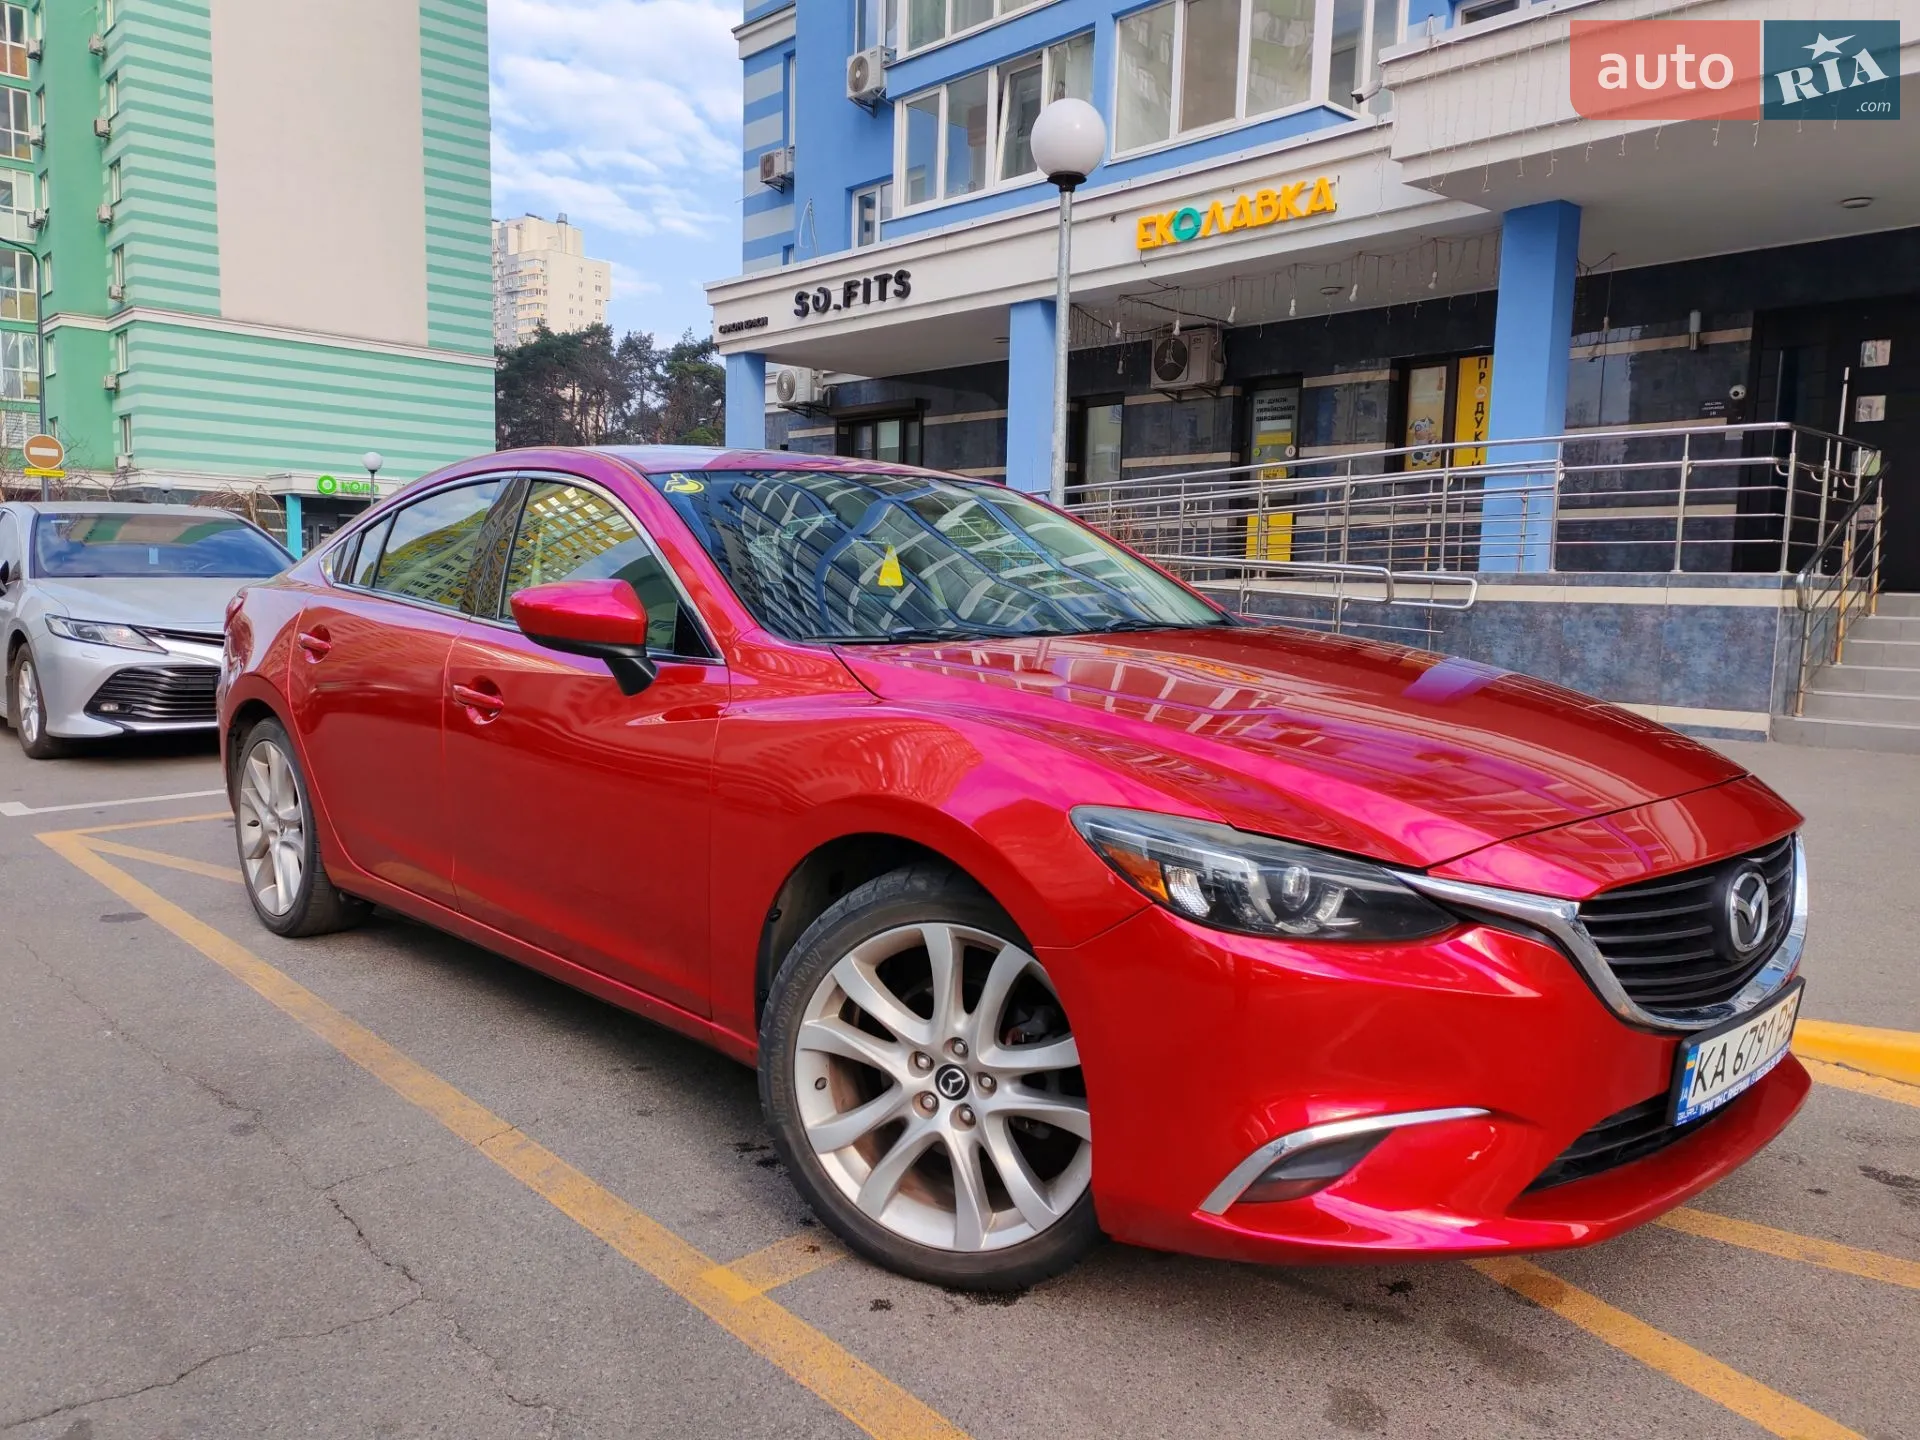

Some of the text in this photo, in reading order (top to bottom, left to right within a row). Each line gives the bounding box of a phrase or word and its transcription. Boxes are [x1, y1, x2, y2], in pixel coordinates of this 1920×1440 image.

[1136, 177, 1337, 250] ЕКОЛАВКА
[793, 269, 912, 318] SO.FITS
[1692, 1042, 1728, 1098] KA
